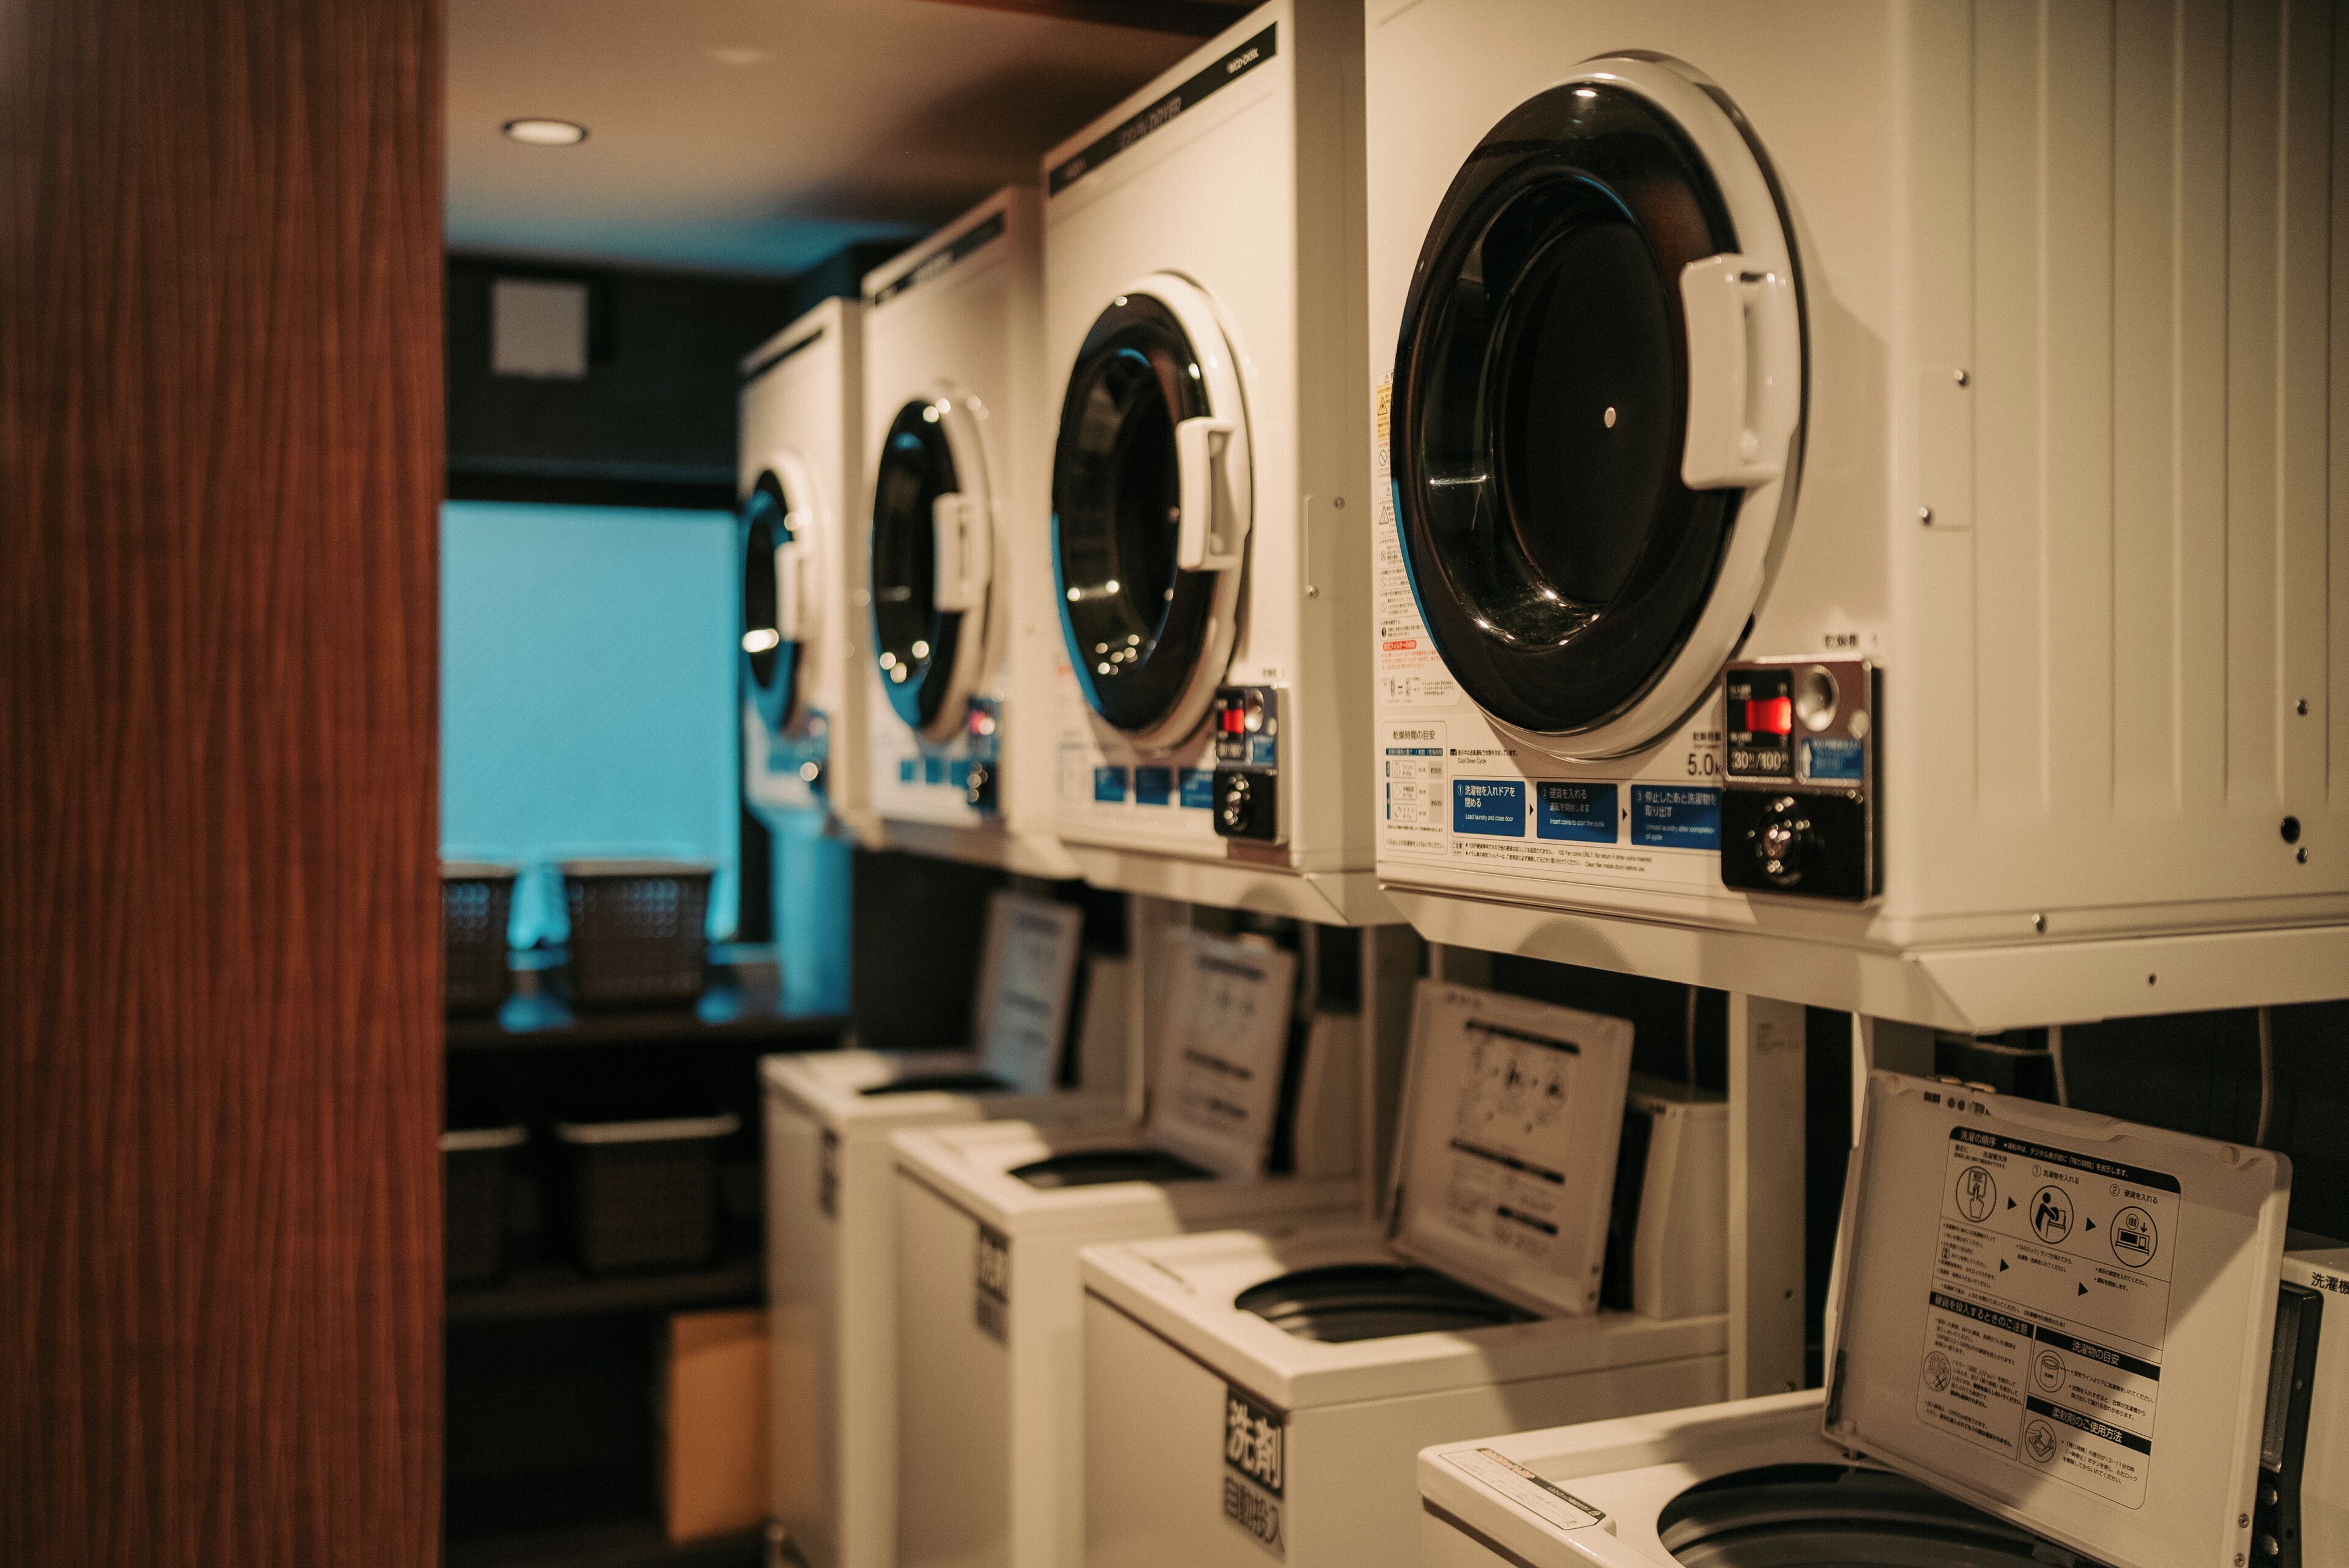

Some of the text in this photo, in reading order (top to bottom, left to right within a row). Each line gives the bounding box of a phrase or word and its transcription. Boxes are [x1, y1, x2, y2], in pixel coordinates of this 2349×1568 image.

[1393, 730, 1436, 741] 乾燥時間の目安
[1464, 785, 1515, 797] 洗濯物を入れドアを
[1549, 788, 1587, 801] 硬貨を入れる
[1464, 798, 1482, 808] 閉める
[1645, 792, 1717, 805] 停止したあと洗濯物を
[1549, 802, 1590, 812] 運転を開始します
[1646, 805, 1673, 818] 取り出す
[1662, 824, 1678, 833] laundry
[1690, 826, 1716, 835] completion
[1960, 1129, 1997, 1147] 洗濯の順序
[2043, 1169, 2080, 1185] 洗濯物を入れる
[2124, 1189, 2159, 1204] 硬貨を入れる
[1935, 1295, 2028, 1334] 硬貨を投入するときのご注意
[2072, 1340, 2120, 1366] 洗濯物の目安
[2052, 1407, 2123, 1443] 柔軟剤のご使用方法
[1227, 1397, 1283, 1491] 洗剤
[1225, 1475, 1286, 1553] 自動投入
